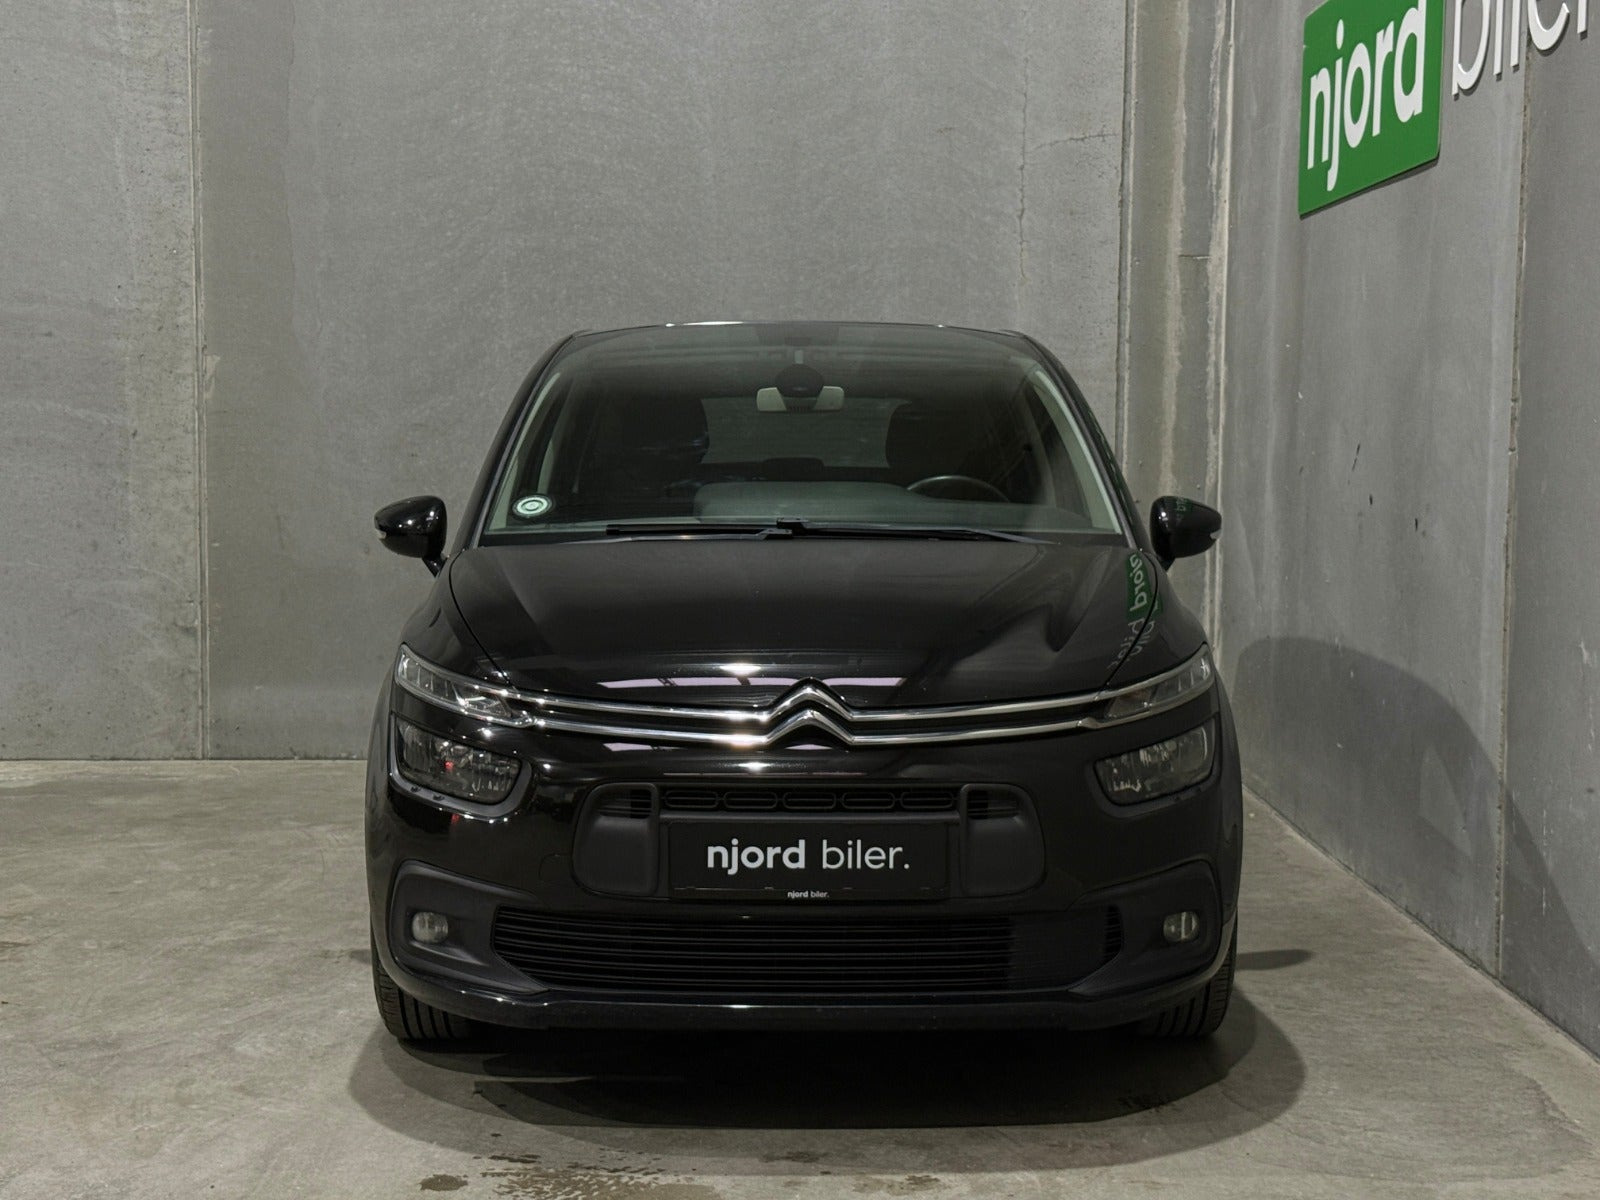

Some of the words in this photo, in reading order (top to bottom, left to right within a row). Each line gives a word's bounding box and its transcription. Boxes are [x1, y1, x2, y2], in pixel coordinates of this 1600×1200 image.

[1307, 0, 1427, 192] njord
[707, 838, 806, 875] njord
[822, 839, 910, 870] biler.
[787, 890, 809, 899] njord
